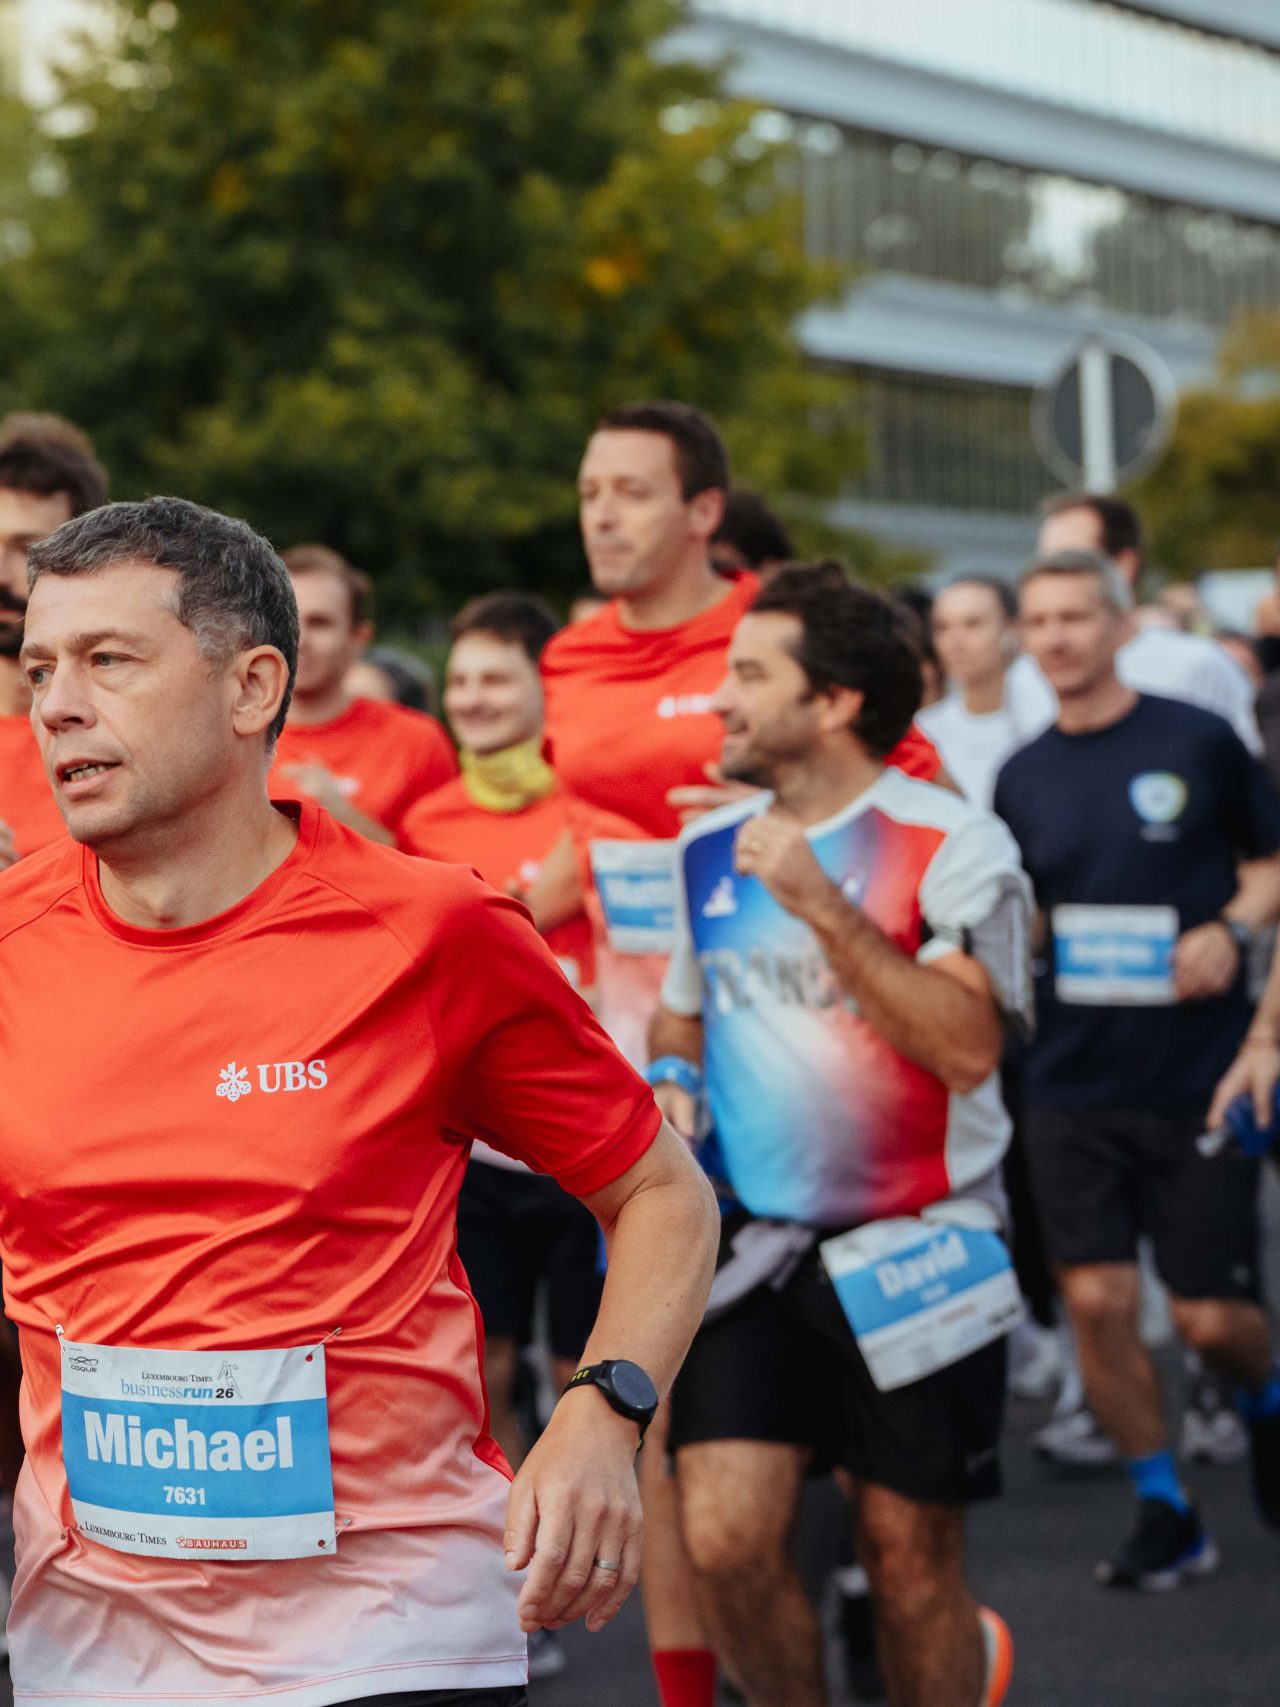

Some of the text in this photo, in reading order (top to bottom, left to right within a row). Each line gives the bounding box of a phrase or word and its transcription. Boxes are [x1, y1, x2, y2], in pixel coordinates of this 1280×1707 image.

[257, 1059, 328, 1093] UBS
[876, 1230, 970, 1299] David
[70, 1364, 97, 1373] COQUE
[141, 1371, 213, 1383] LUXEMBOURG TIMES
[216, 1388, 234, 1399] 26
[84, 1410, 294, 1472] Michael
[163, 1485, 206, 1505] 7631
[85, 1520, 167, 1546] LUXEMBOURG TIMES
[187, 1539, 246, 1549] BAUHAUS
